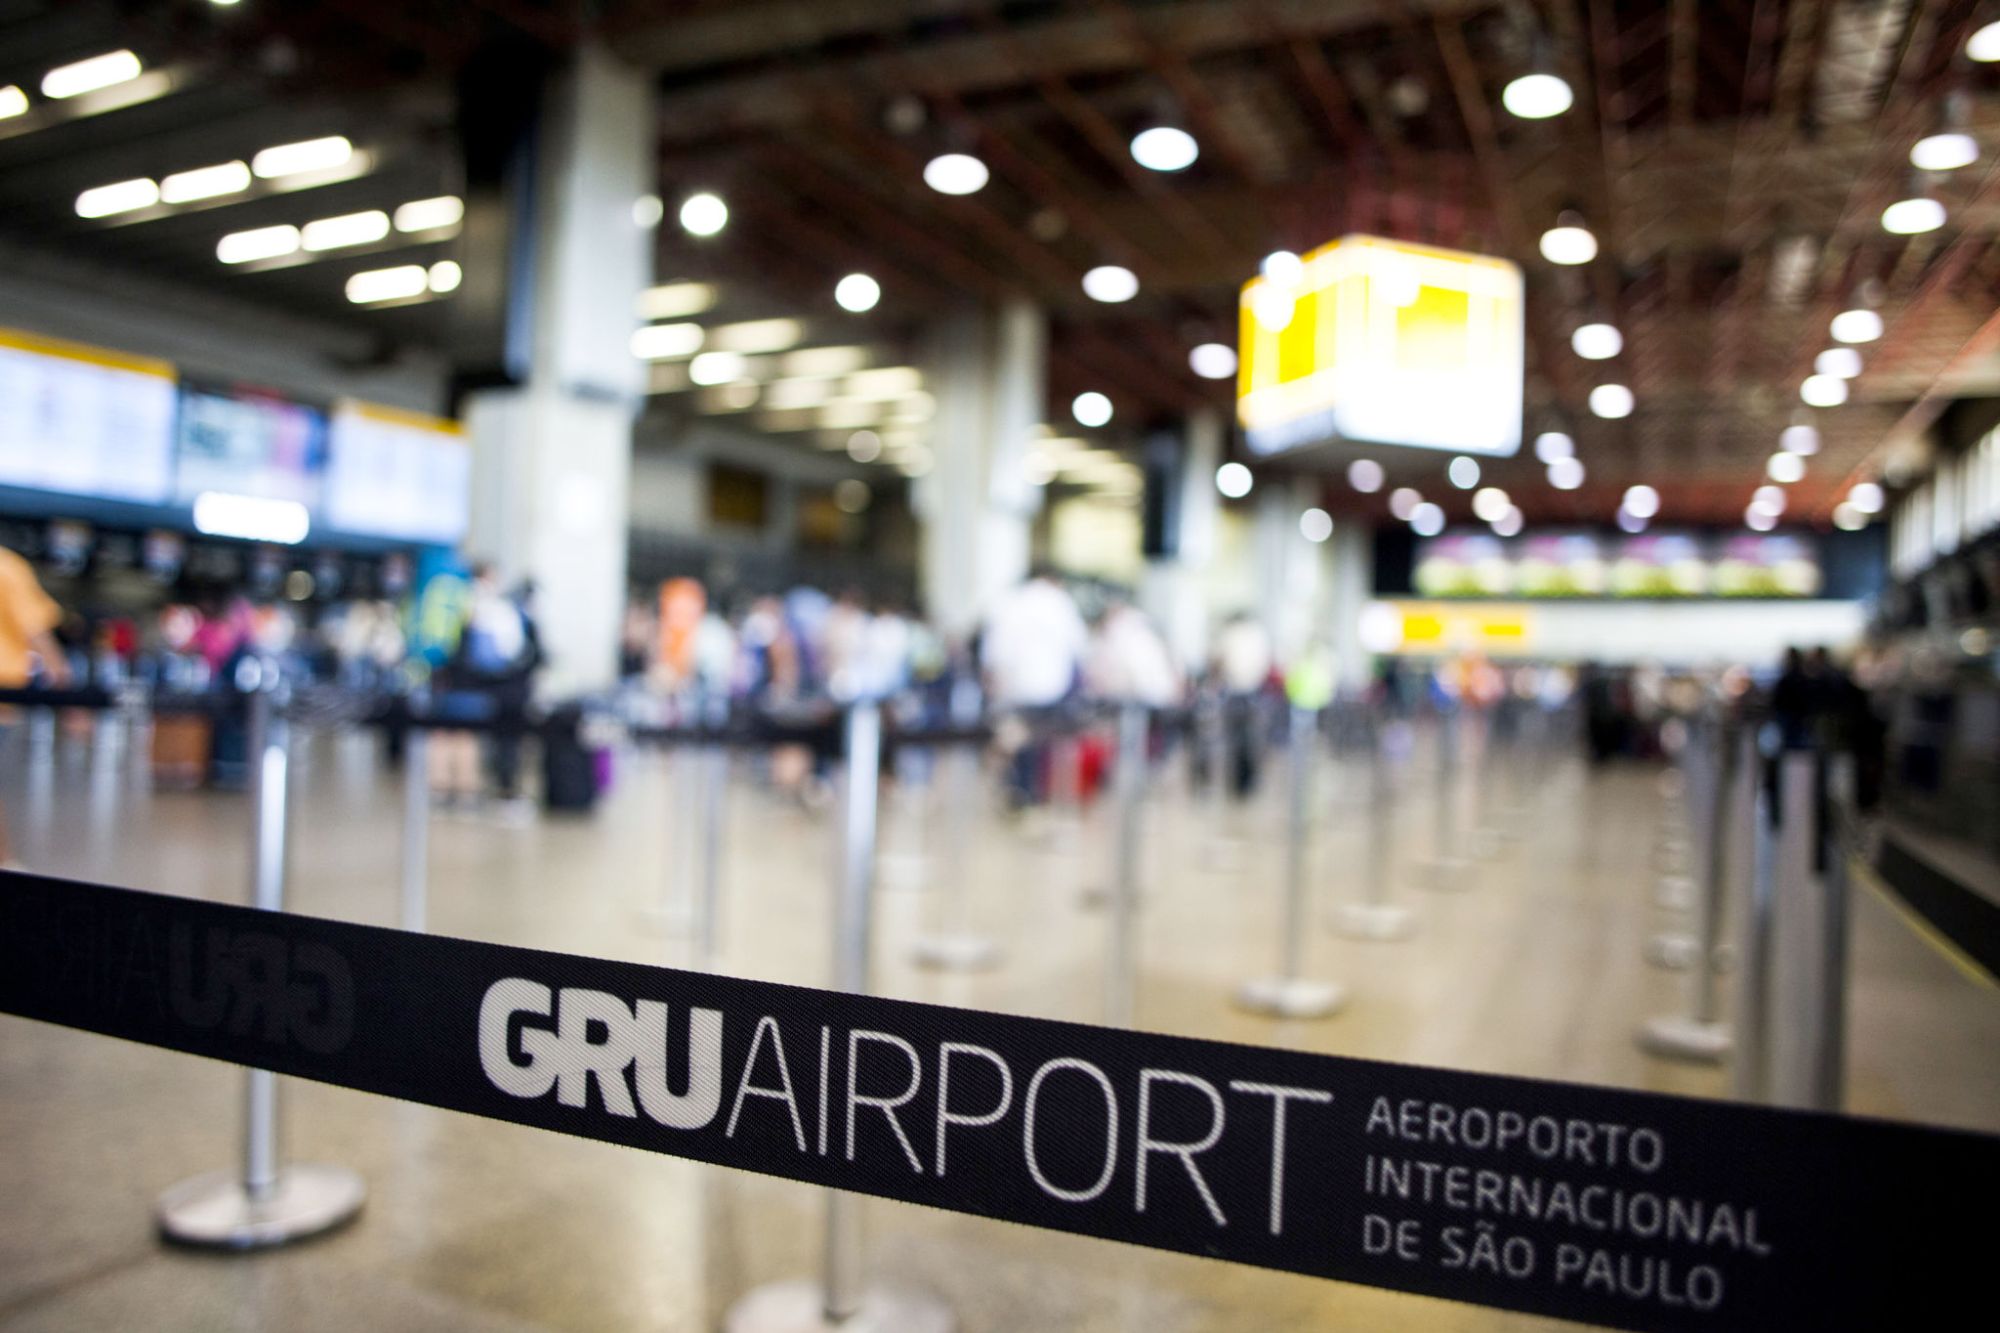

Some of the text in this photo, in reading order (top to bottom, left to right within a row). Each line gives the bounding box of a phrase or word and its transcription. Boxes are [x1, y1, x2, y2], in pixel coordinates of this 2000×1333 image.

[1365, 1095, 1663, 1172] AEROPORTO
[1364, 1154, 1772, 1255] INTERNACIONAL
[1362, 1214, 1724, 1310] DE SÃO PAULO
